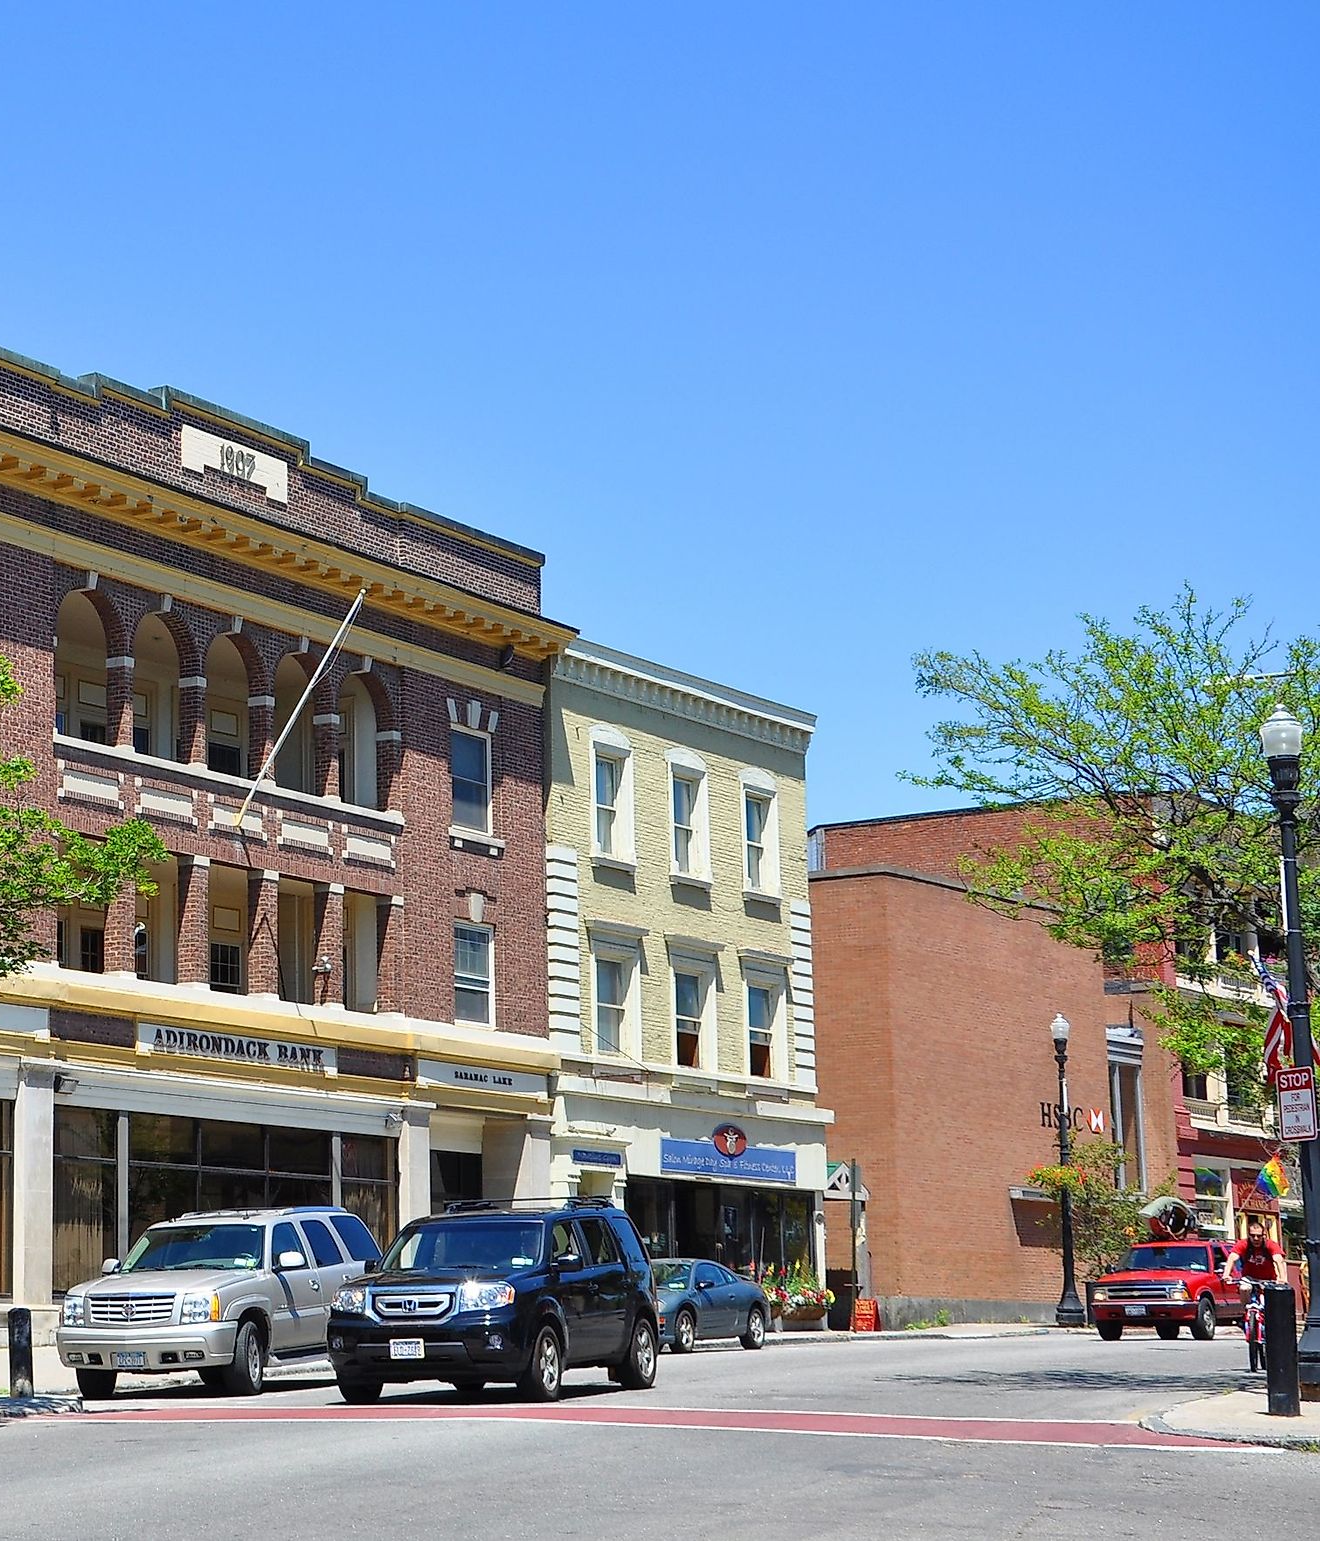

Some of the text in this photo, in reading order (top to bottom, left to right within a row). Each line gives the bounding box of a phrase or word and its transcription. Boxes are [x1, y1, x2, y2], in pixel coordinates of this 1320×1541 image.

[220, 443, 256, 480] 1907
[154, 1028, 324, 1066] ADIRONDACK BANK
[454, 1071, 513, 1086] SARANAC LAKE
[1279, 1072, 1309, 1088] STOP
[663, 1153, 681, 1164] Salon
[719, 1158, 731, 1169] Spa
